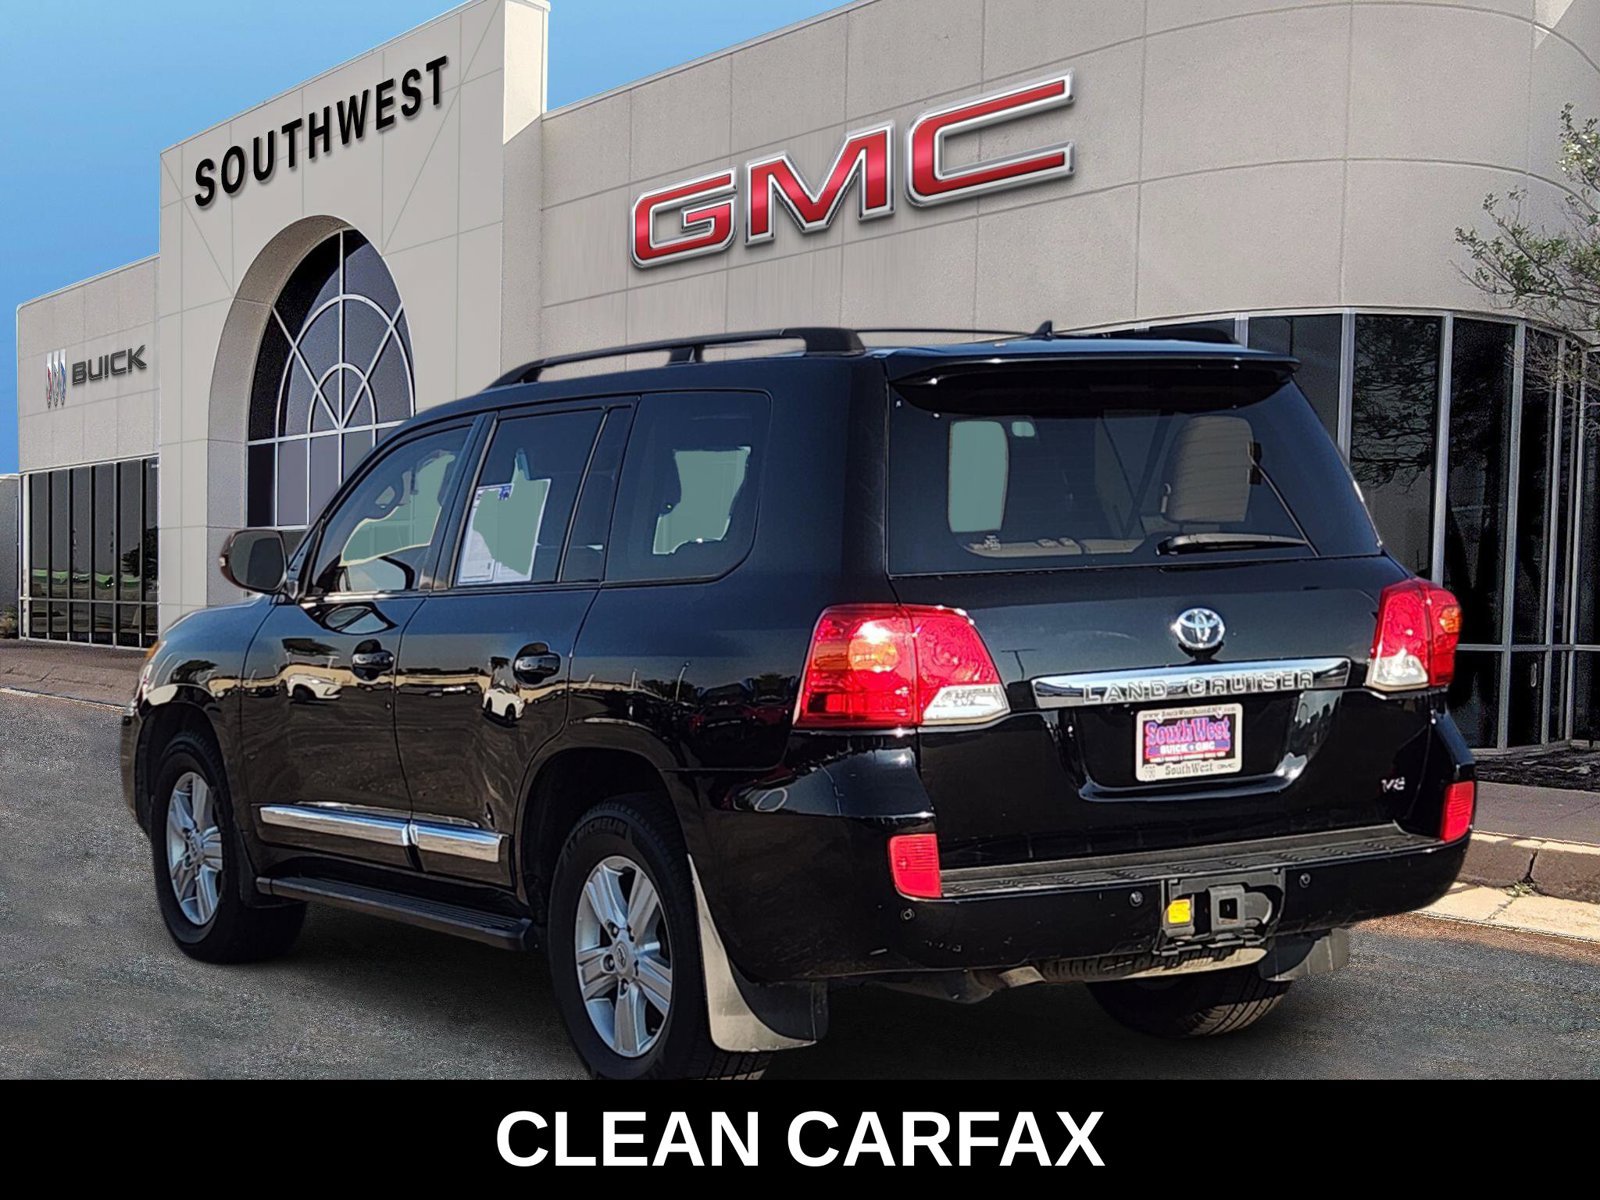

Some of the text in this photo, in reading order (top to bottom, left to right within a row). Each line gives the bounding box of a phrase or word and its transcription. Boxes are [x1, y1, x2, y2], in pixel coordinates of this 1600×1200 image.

[194, 55, 449, 207] SOUTHWEST
[630, 69, 1076, 268] GMC
[72, 344, 147, 386] BUICK
[1082, 669, 1314, 704] LAND CRUISER
[1145, 716, 1231, 746] SouthWest
[1160, 743, 1188, 755] BUICK
[1381, 776, 1405, 792] V8
